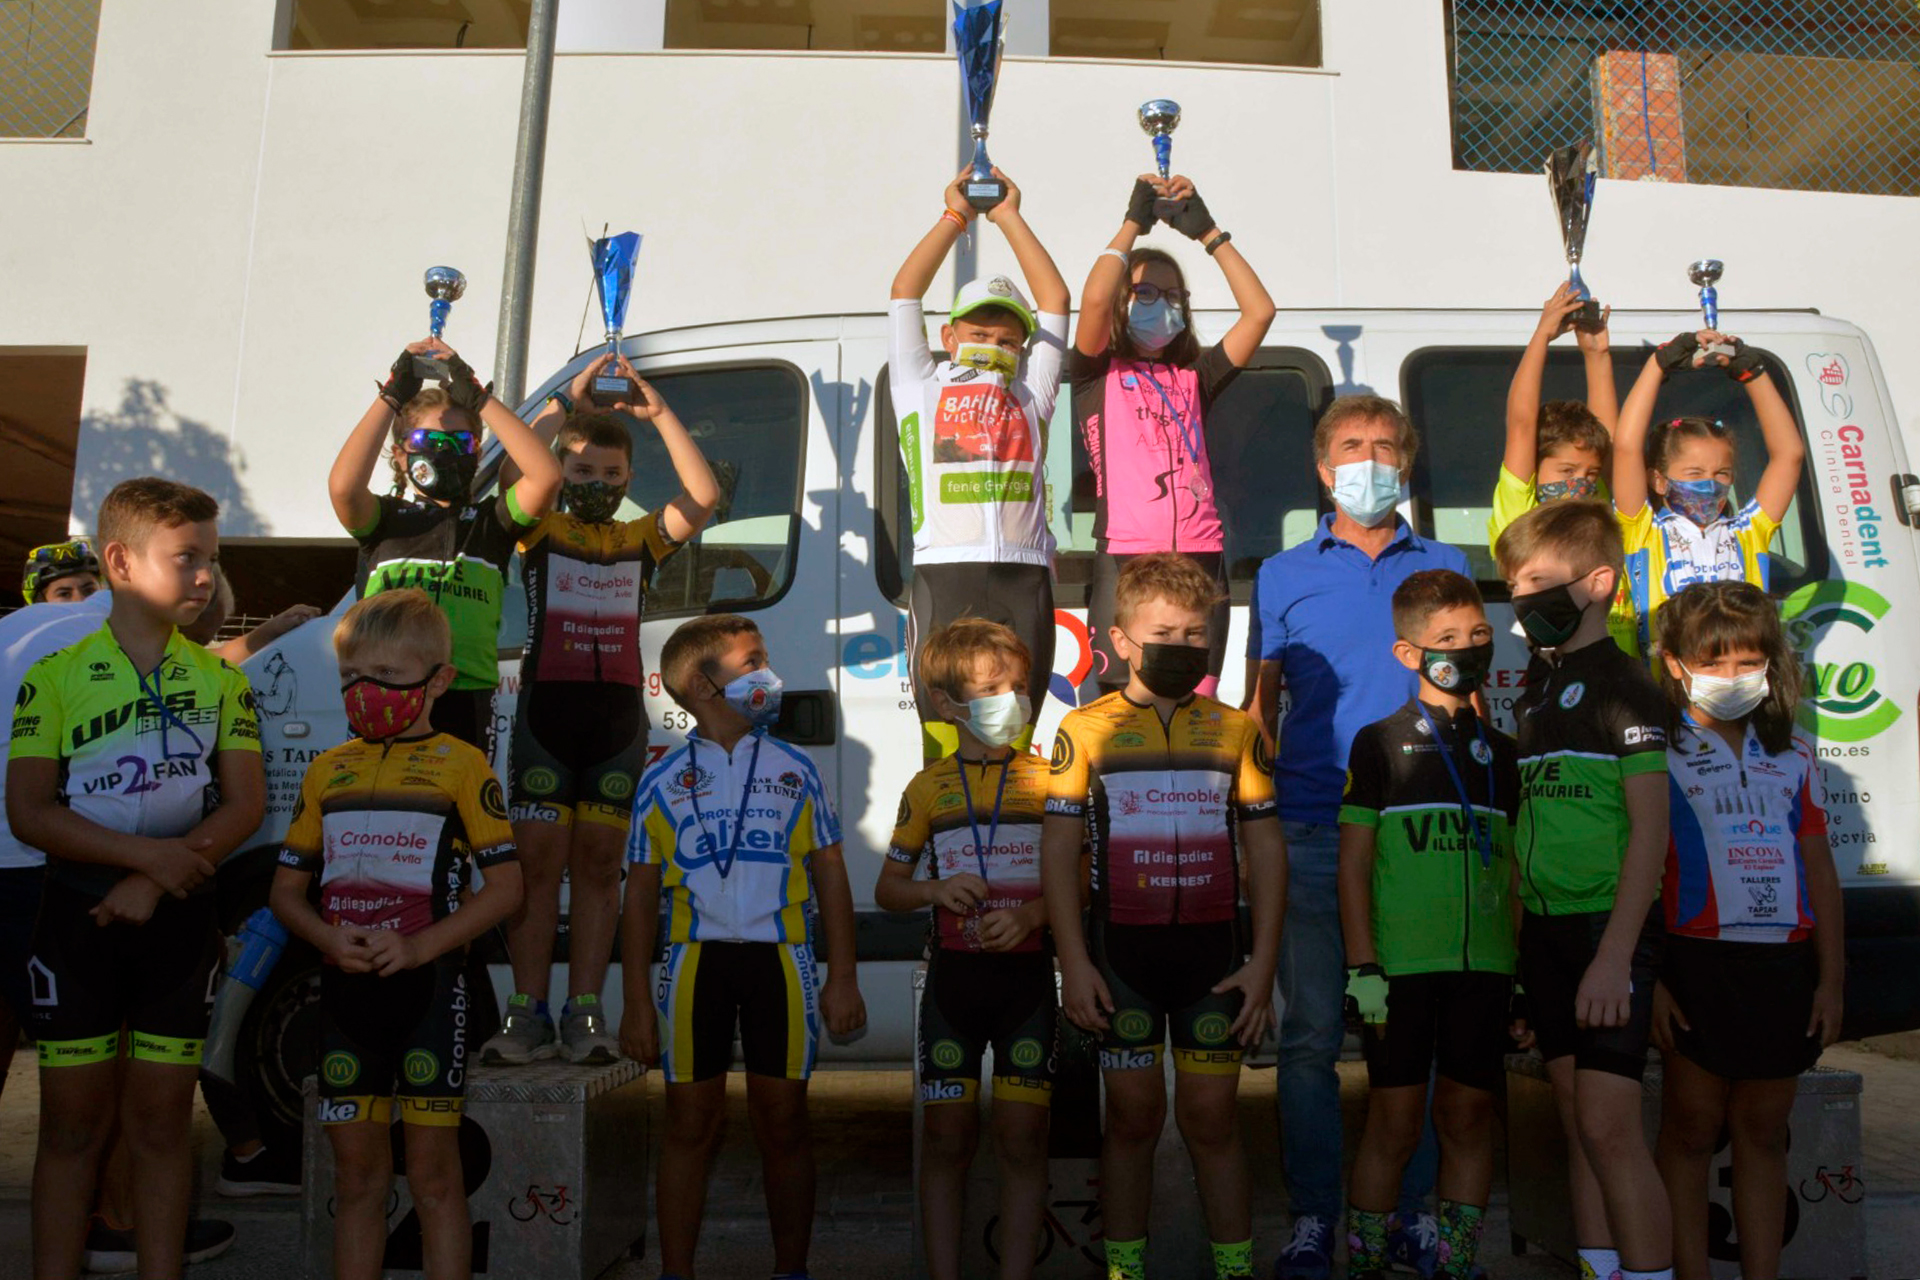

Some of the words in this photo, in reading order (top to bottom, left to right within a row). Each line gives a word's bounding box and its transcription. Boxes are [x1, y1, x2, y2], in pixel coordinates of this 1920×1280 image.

[944, 392, 1001, 416] BAHR
[946, 478, 981, 494] fenie
[1837, 425, 1890, 569] Carnadent
[1836, 504, 1858, 565] Dental
[83, 772, 123, 794] VIP
[153, 759, 197, 780] FAN
[1145, 787, 1221, 805] Cronoble
[340, 830, 428, 850] Cronoble
[1402, 810, 1488, 853] VIVE
[1829, 828, 1877, 849] govia
[961, 841, 1034, 857] Conoble
[1728, 846, 1784, 859] INCOVA
[1740, 876, 1782, 884] TALLERES
[1747, 906, 1779, 914] TAPIAS
[446, 972, 468, 1089] Cronoble
[1099, 1048, 1155, 1072] Bike
